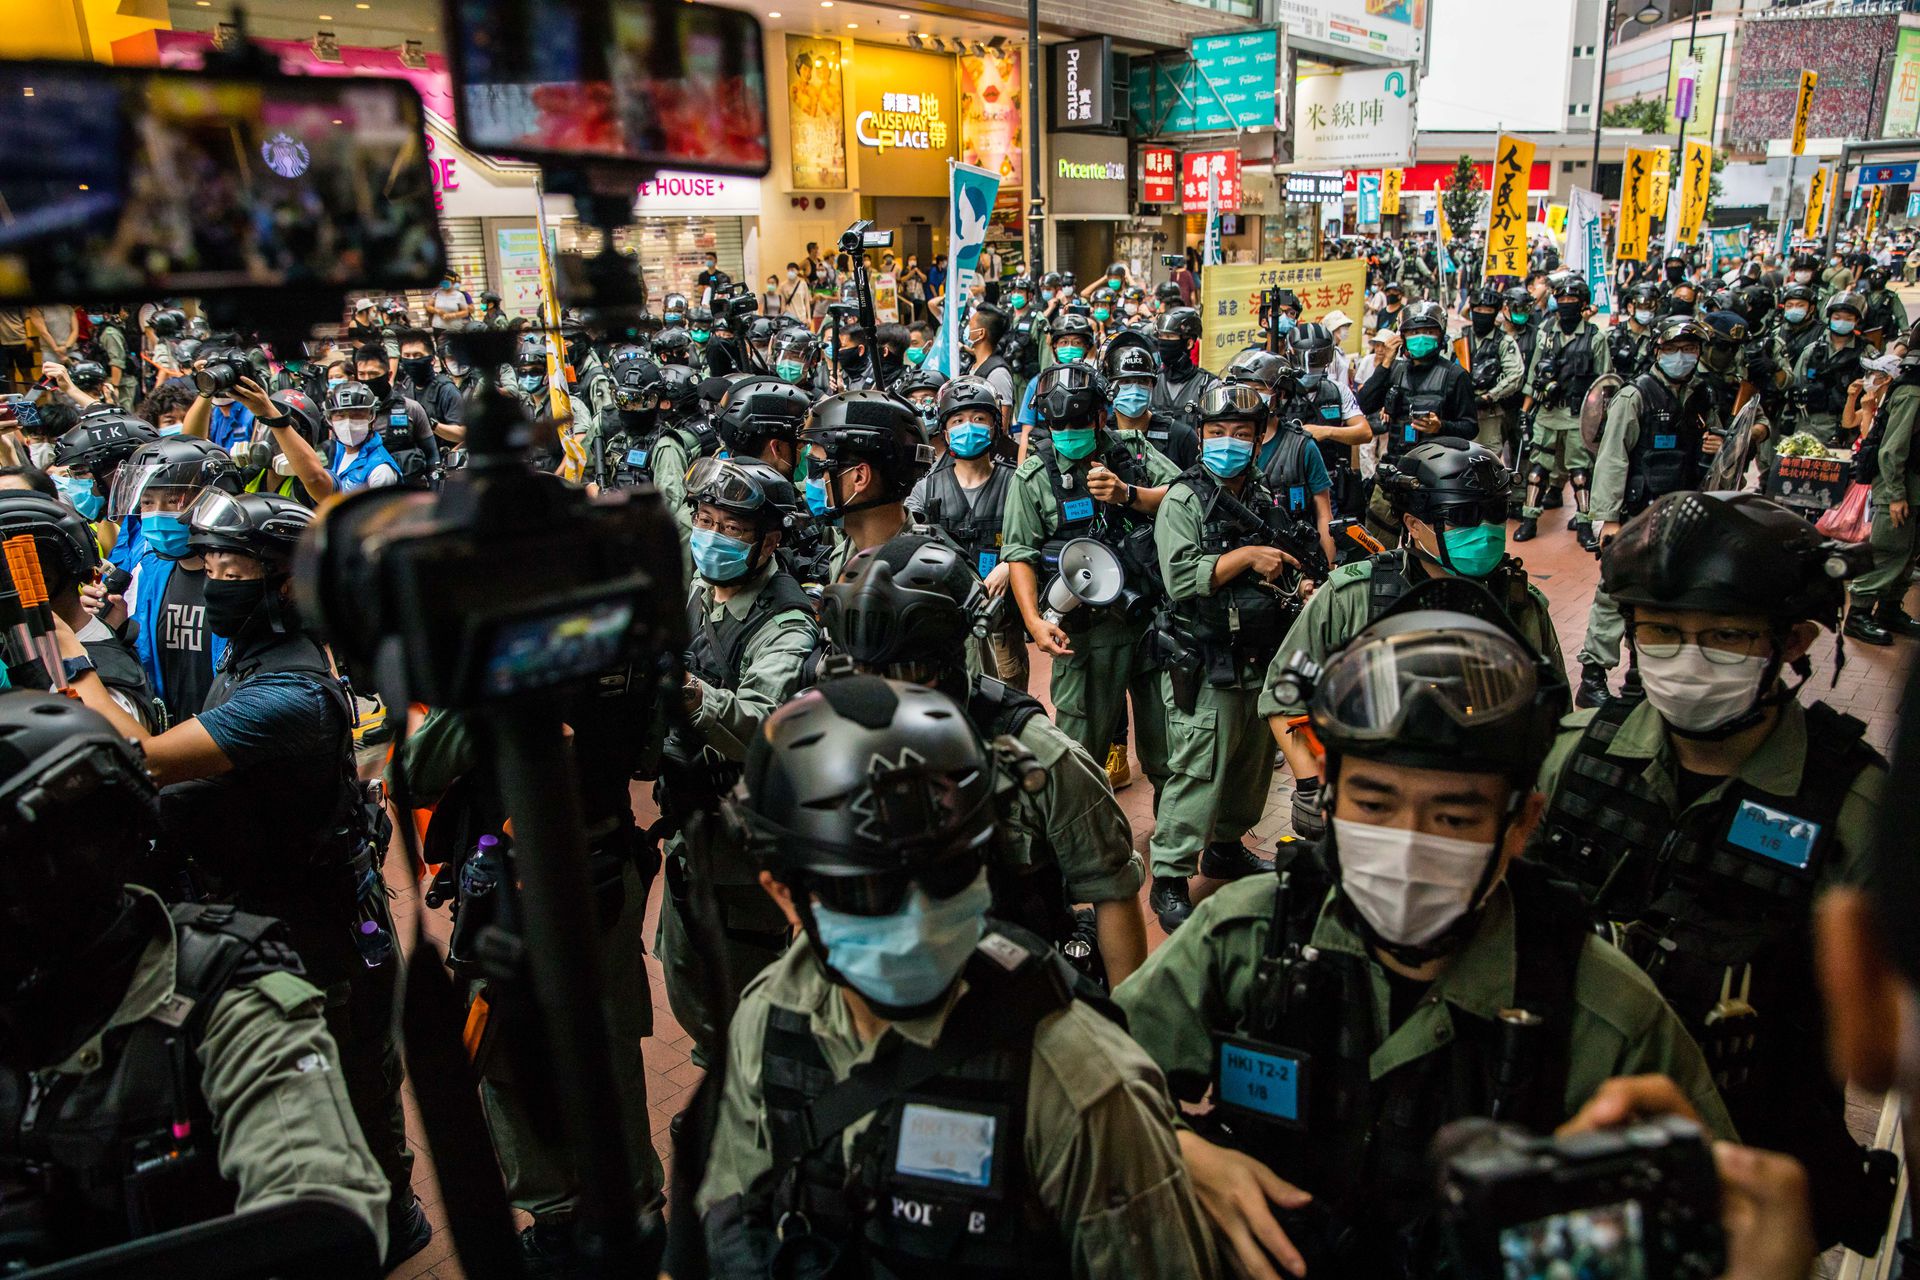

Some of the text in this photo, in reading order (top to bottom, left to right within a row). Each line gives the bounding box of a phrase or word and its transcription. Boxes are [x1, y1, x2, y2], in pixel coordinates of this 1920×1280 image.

[1305, 99, 1383, 131] 米線陣
[856, 111, 928, 146] CAUSEWAY
[1315, 133, 1370, 142] mixian sense
[878, 130, 929, 154] PLACE
[656, 178, 715, 196] HOUSE
[1492, 145, 1524, 270] 人民力量
[92, 426, 122, 440] T.K
[1228, 1053, 1289, 1081] HKI T2-2
